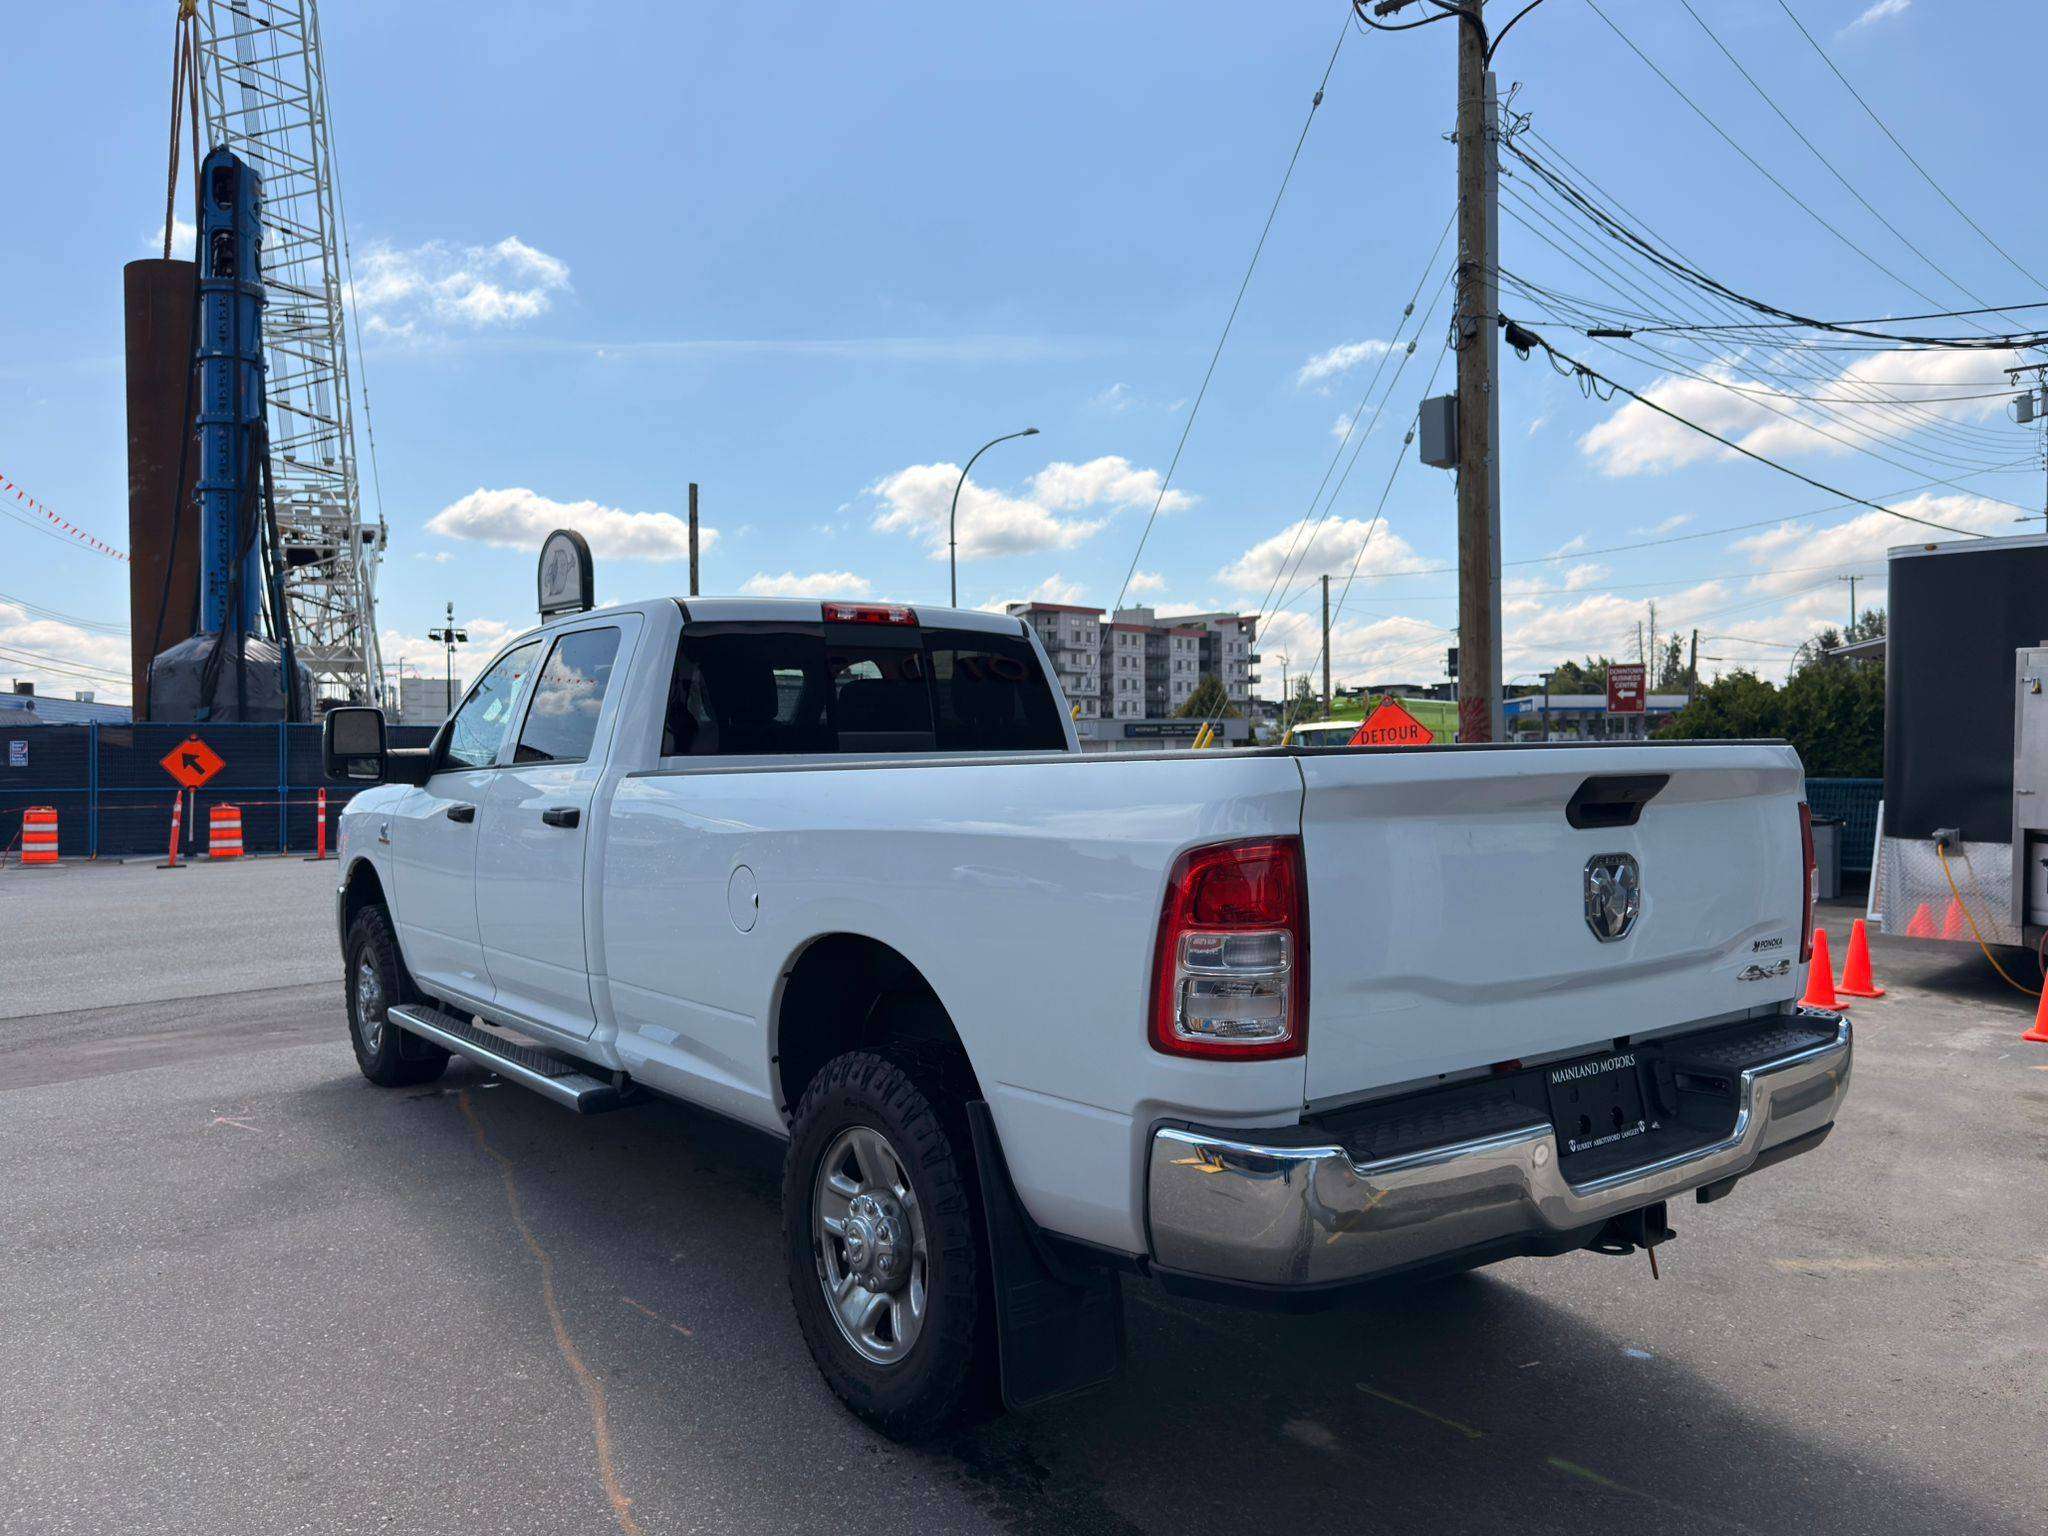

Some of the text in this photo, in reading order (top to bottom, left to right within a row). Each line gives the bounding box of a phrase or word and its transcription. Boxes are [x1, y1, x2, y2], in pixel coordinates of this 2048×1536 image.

[1361, 724, 1419, 745] DETOUR
[1552, 1053, 1636, 1084] MAINLAND MOTORS
